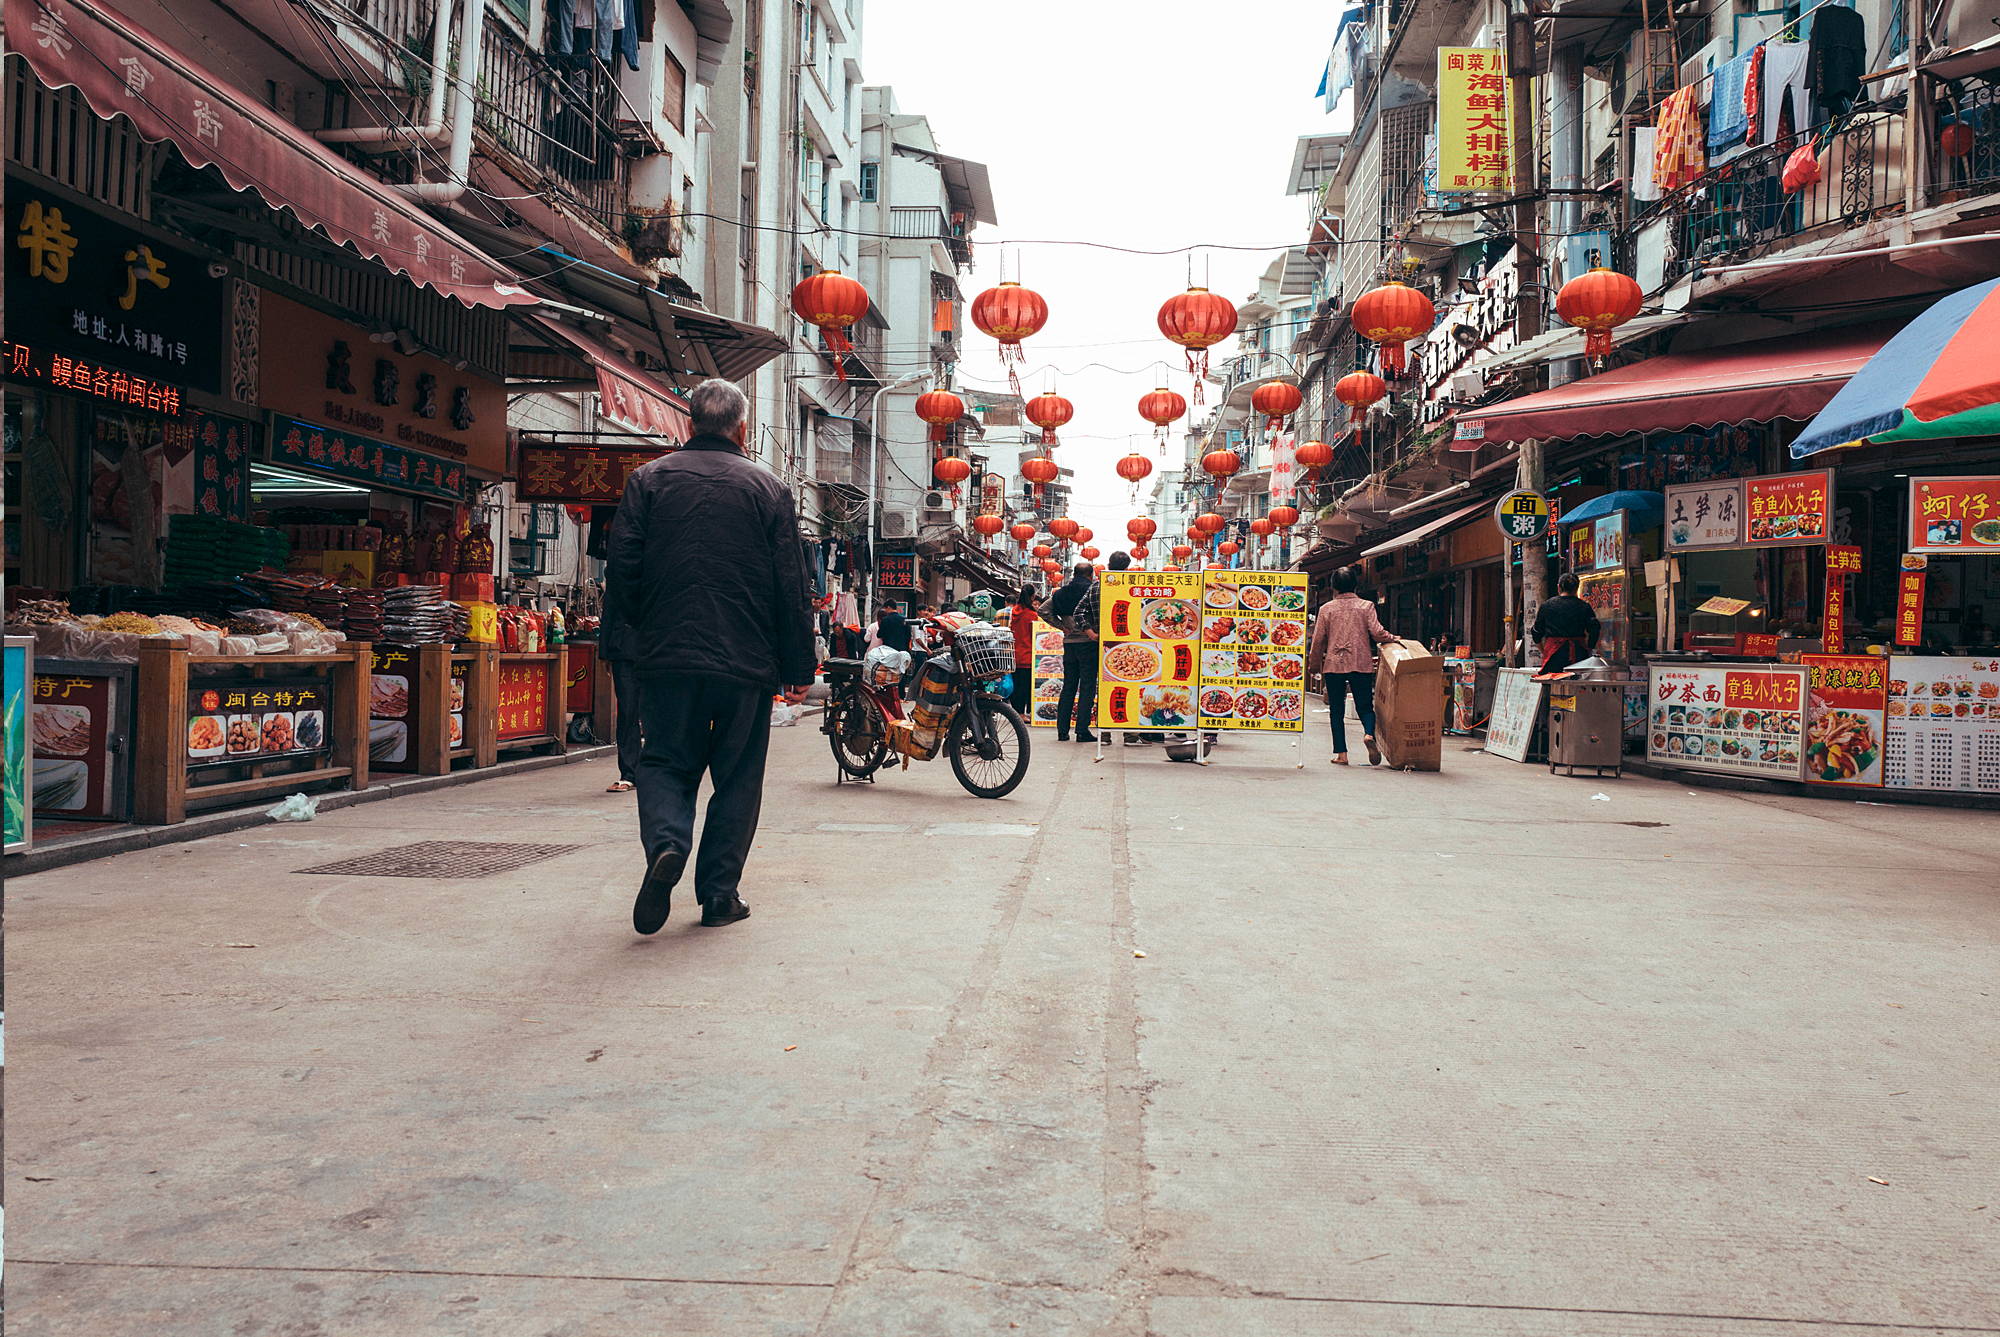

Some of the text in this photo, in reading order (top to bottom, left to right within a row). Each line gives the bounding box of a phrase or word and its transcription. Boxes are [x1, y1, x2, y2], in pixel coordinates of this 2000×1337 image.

[31, 4, 223, 148] 美食街
[1466, 73, 1510, 172] 海鲜大排档
[17, 199, 171, 311] 特产
[371, 209, 466, 286] 美食街
[1670, 492, 1737, 528] 土笋冻
[1751, 488, 1824, 518] 章鱼小丸子
[1827, 550, 1862, 570] 土笋冻
[975, 595, 989, 609] 茶
[1132, 587, 1173, 598] 美食功略
[1590, 581, 1622, 611] 沙茶面
[1115, 602, 1128, 635] 沙茶面
[1827, 589, 1841, 654] 大肠包小肠
[1901, 575, 1921, 642] 咖喱鱼蛋
[498, 667, 532, 685] 大红袍
[1176, 647, 1188, 679] 蚵仔煎
[224, 690, 317, 708] 闽台特产
[498, 689, 531, 708] 正山小种
[1114, 689, 1126, 721] 土笋冻
[1658, 681, 1721, 704] 沙茶面
[1727, 677, 1799, 704] 章鱼小丸子
